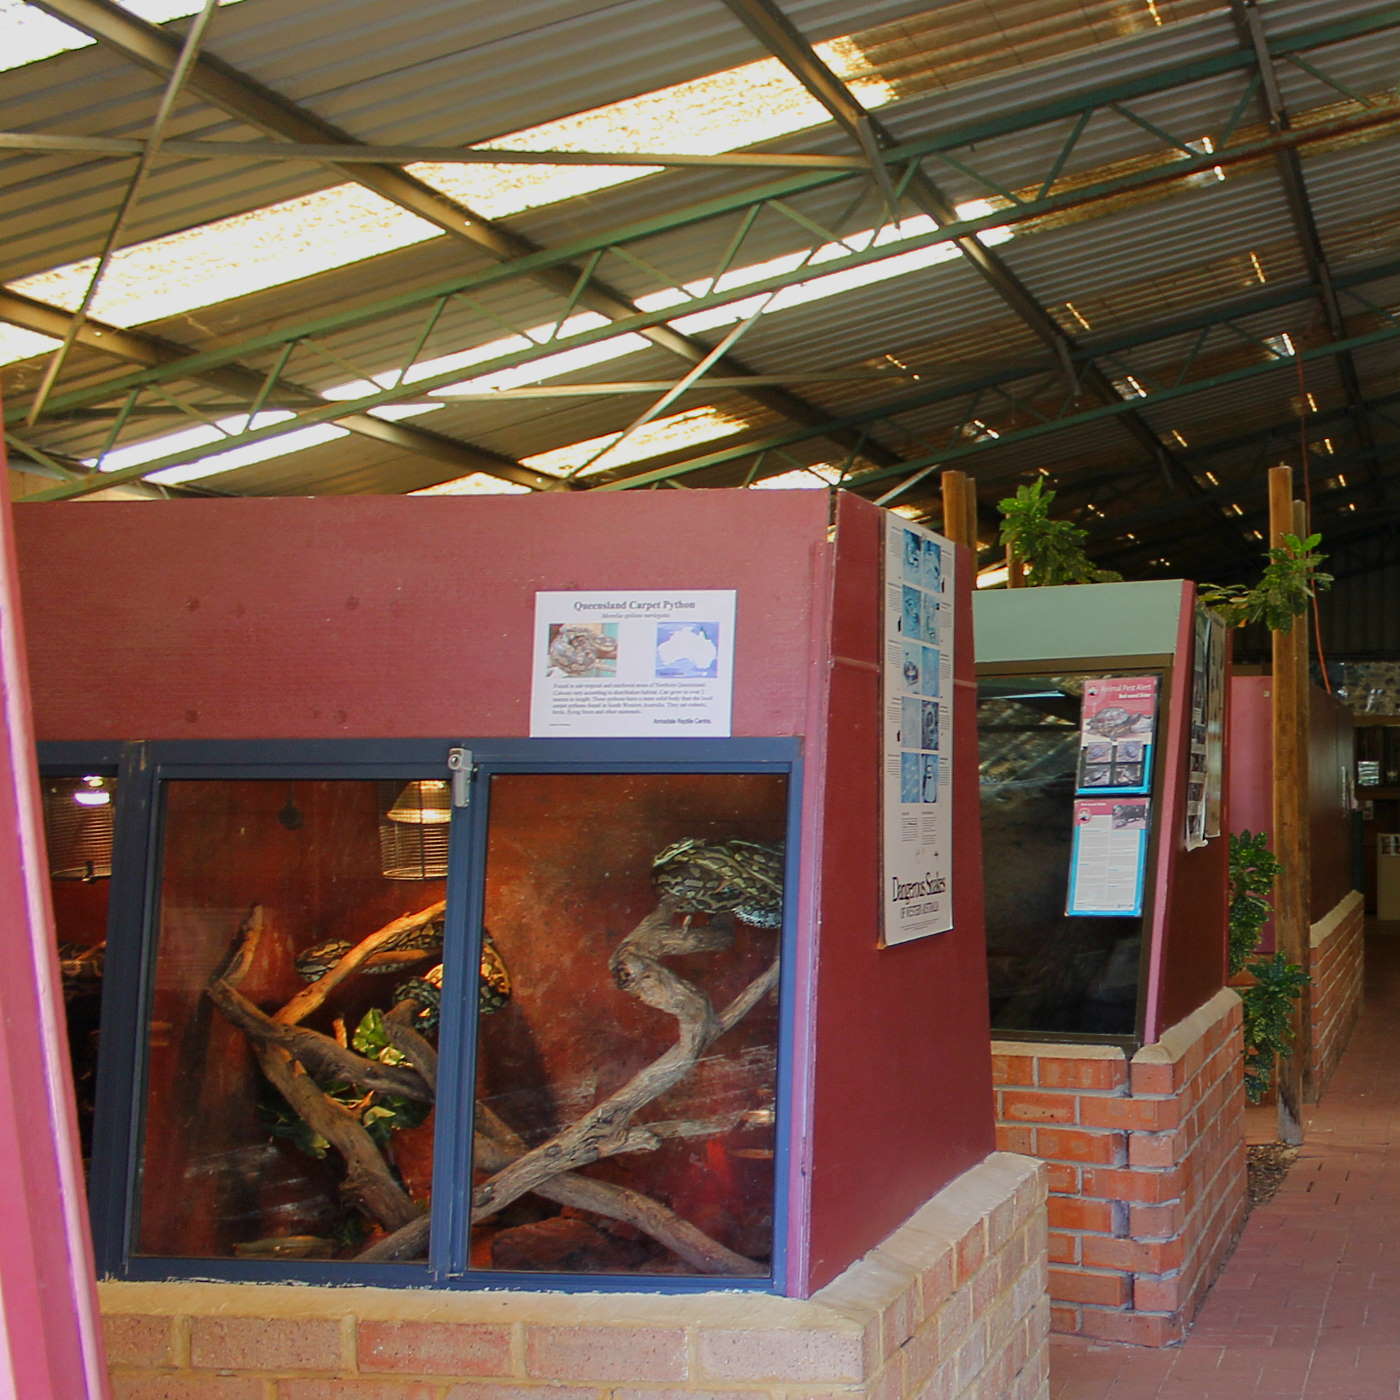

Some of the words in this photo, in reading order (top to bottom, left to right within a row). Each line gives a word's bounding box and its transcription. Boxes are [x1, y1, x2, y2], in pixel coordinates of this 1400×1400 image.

[573, 600, 627, 611] Queensland
[628, 600, 660, 612] Carpet
[662, 600, 696, 611] Python
